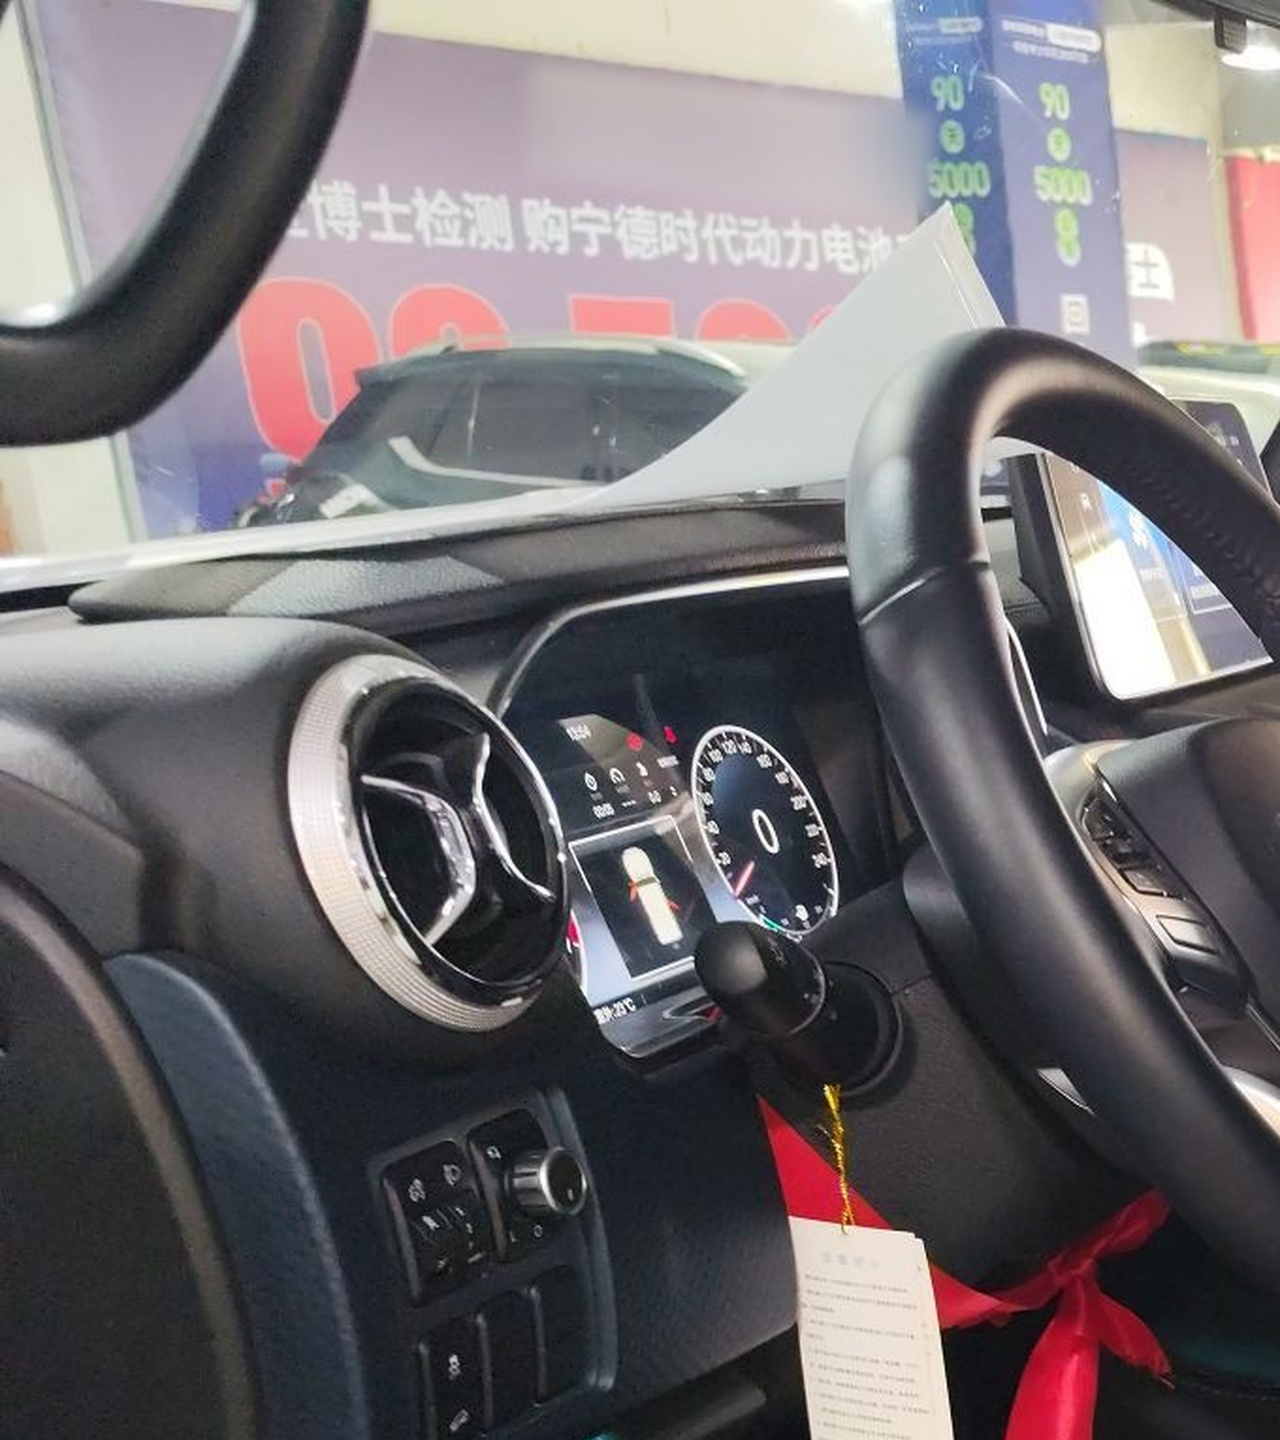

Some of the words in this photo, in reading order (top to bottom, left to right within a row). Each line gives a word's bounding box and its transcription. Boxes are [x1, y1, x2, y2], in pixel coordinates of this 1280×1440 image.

[931, 75, 964, 111] 90
[1039, 82, 1070, 121] 90
[929, 161, 990, 198] 5000
[1034, 165, 1092, 206] 5000
[287, 178, 514, 252] 博士检测
[521, 197, 912, 275] 购宁德时代动力电池
[752, 809, 779, 853] 0
